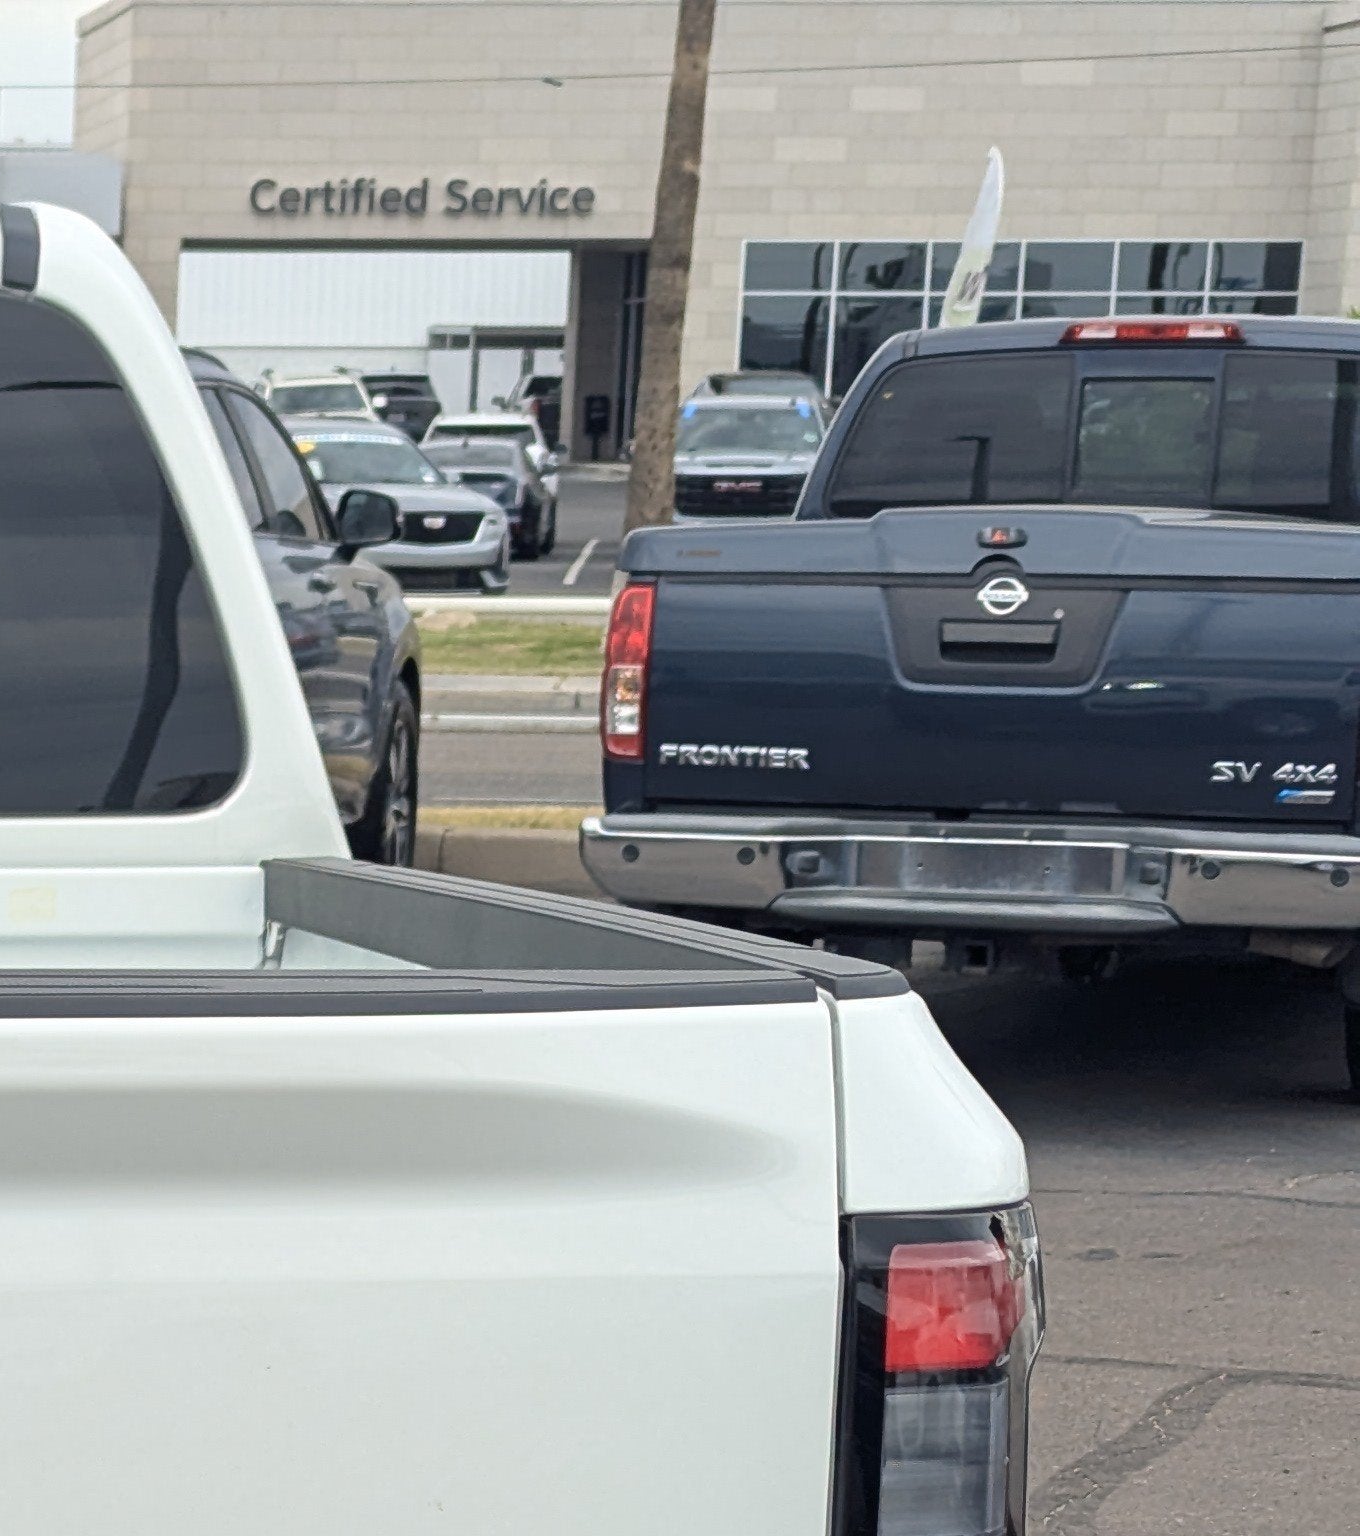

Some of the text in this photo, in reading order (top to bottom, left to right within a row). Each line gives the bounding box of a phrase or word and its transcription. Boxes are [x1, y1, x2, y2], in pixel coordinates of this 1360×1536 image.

[249, 177, 595, 216] Certified Service
[658, 742, 811, 771] FRONTIER
[1209, 760, 1263, 783] SV
